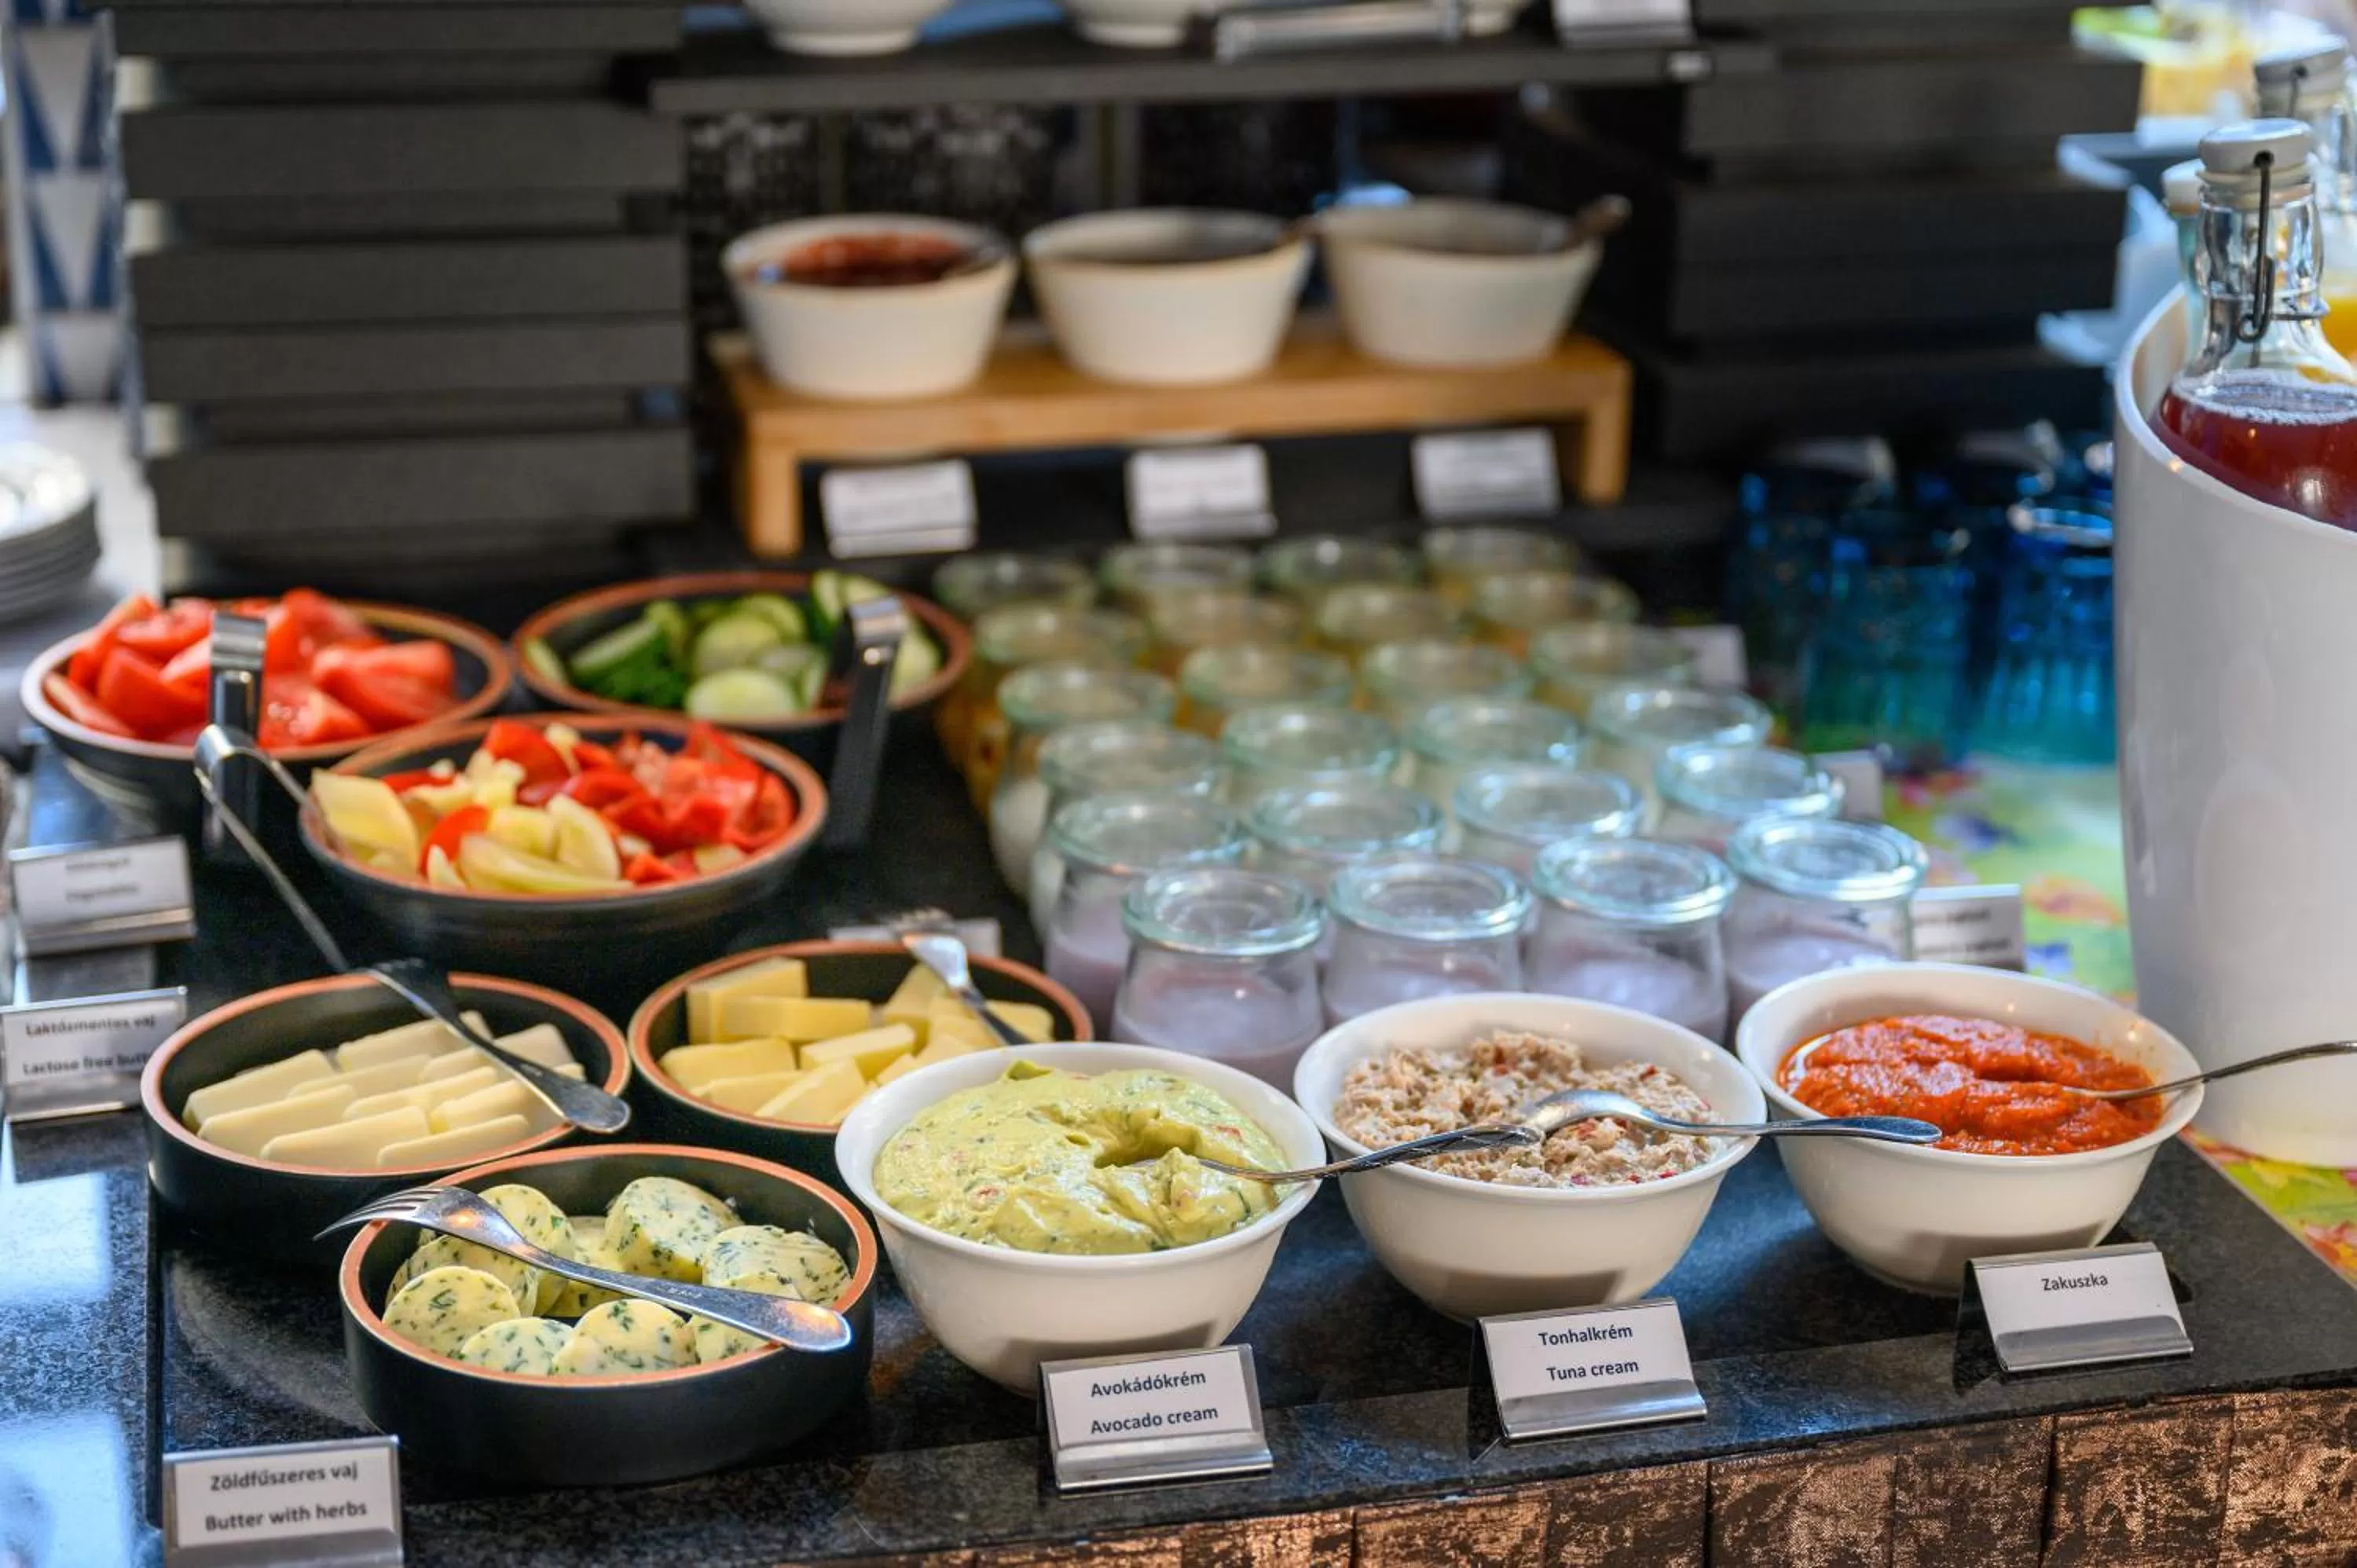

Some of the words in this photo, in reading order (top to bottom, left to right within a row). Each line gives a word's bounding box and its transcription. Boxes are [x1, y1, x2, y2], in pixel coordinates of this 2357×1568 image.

[22, 1059, 79, 1075] Lactose
[83, 1054, 114, 1069] free
[2040, 1272, 2109, 1291] Zakuszka
[1538, 1324, 1633, 1346] Tonhalkrém
[1546, 1365, 1587, 1381] Tuna
[1591, 1359, 1640, 1377] cream
[1091, 1371, 1207, 1398] Avokádókrém
[1091, 1412, 1163, 1434] Avocado
[1168, 1406, 1219, 1425] cream
[331, 1461, 358, 1482] vaj
[205, 1511, 263, 1532] Butter
[269, 1504, 311, 1526] with
[316, 1499, 368, 1519] herbs
